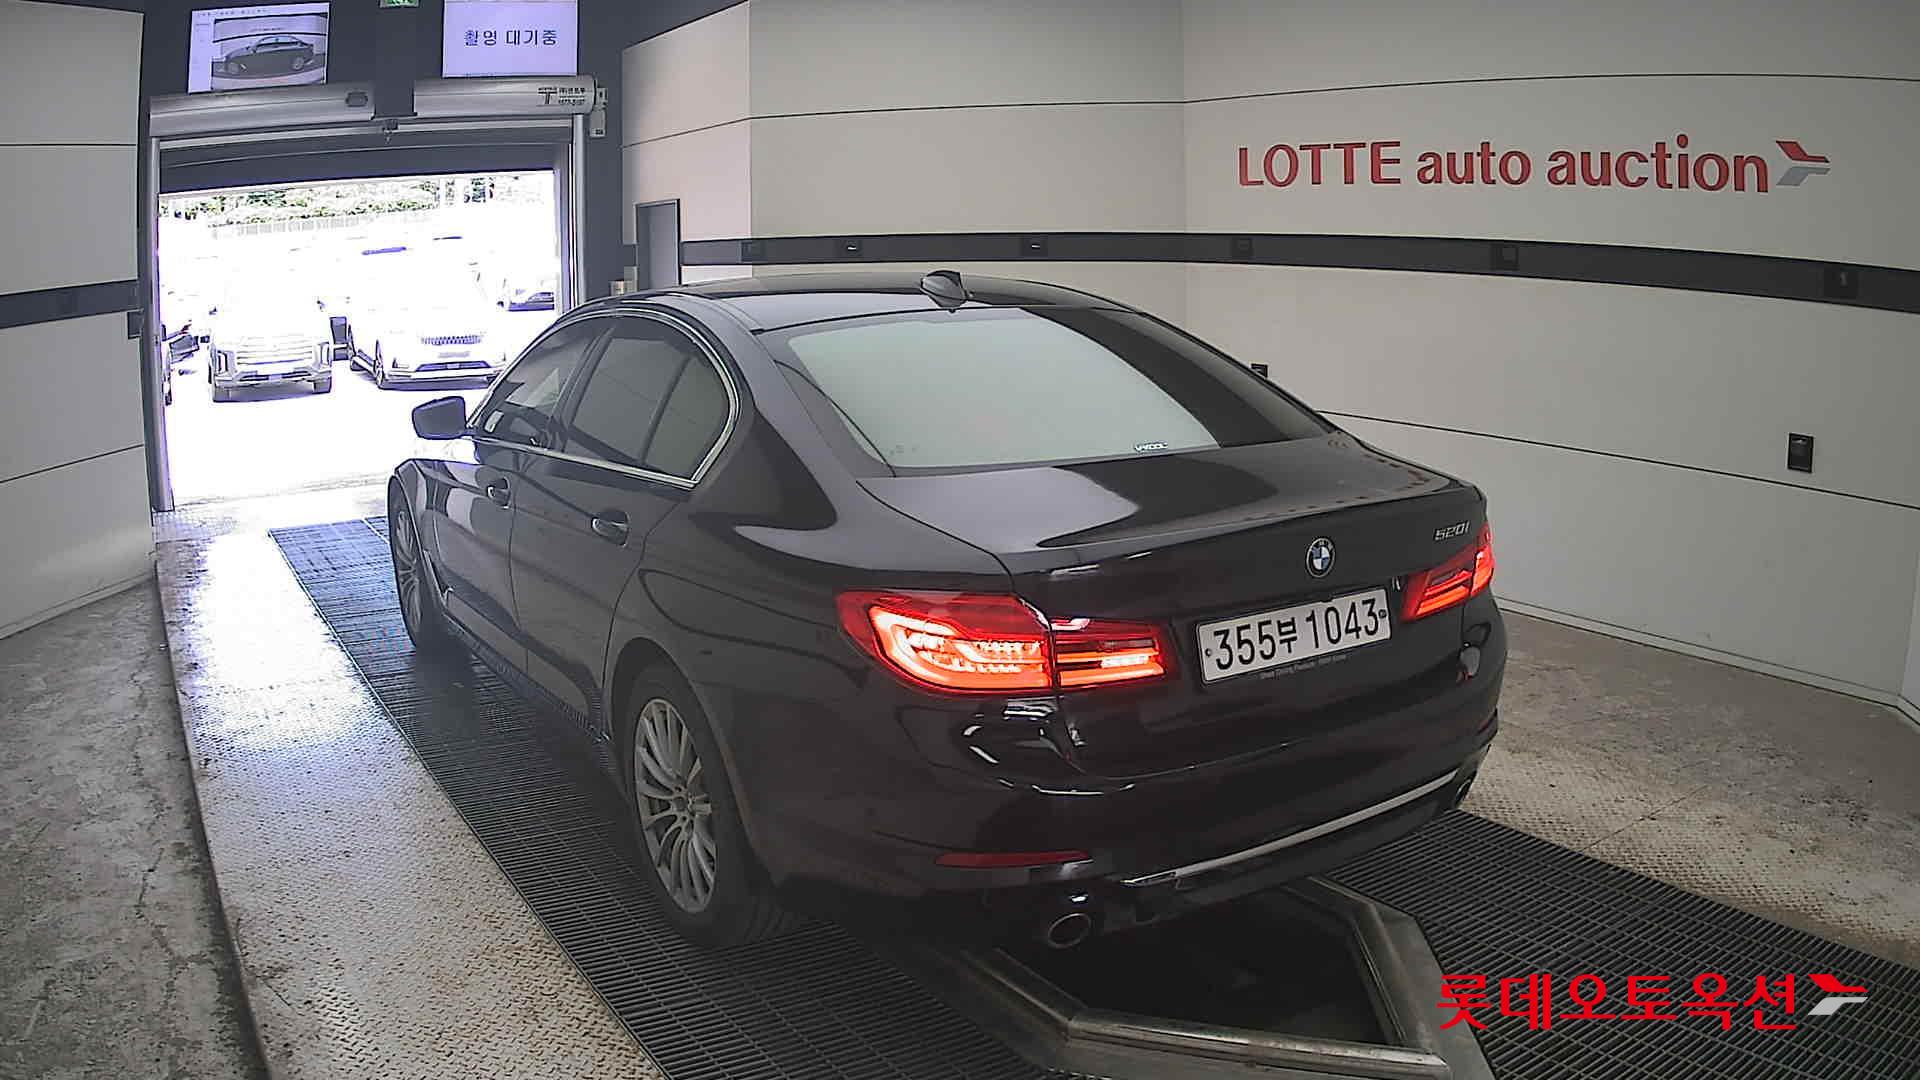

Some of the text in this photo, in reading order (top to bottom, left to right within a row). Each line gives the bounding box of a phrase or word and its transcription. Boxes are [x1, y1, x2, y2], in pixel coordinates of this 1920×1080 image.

[507, 29, 558, 46] 대기중
[1238, 134, 1770, 193] LOTTE auto auction
[1213, 616, 1298, 670] 355부
[1305, 598, 1380, 649] 1043
